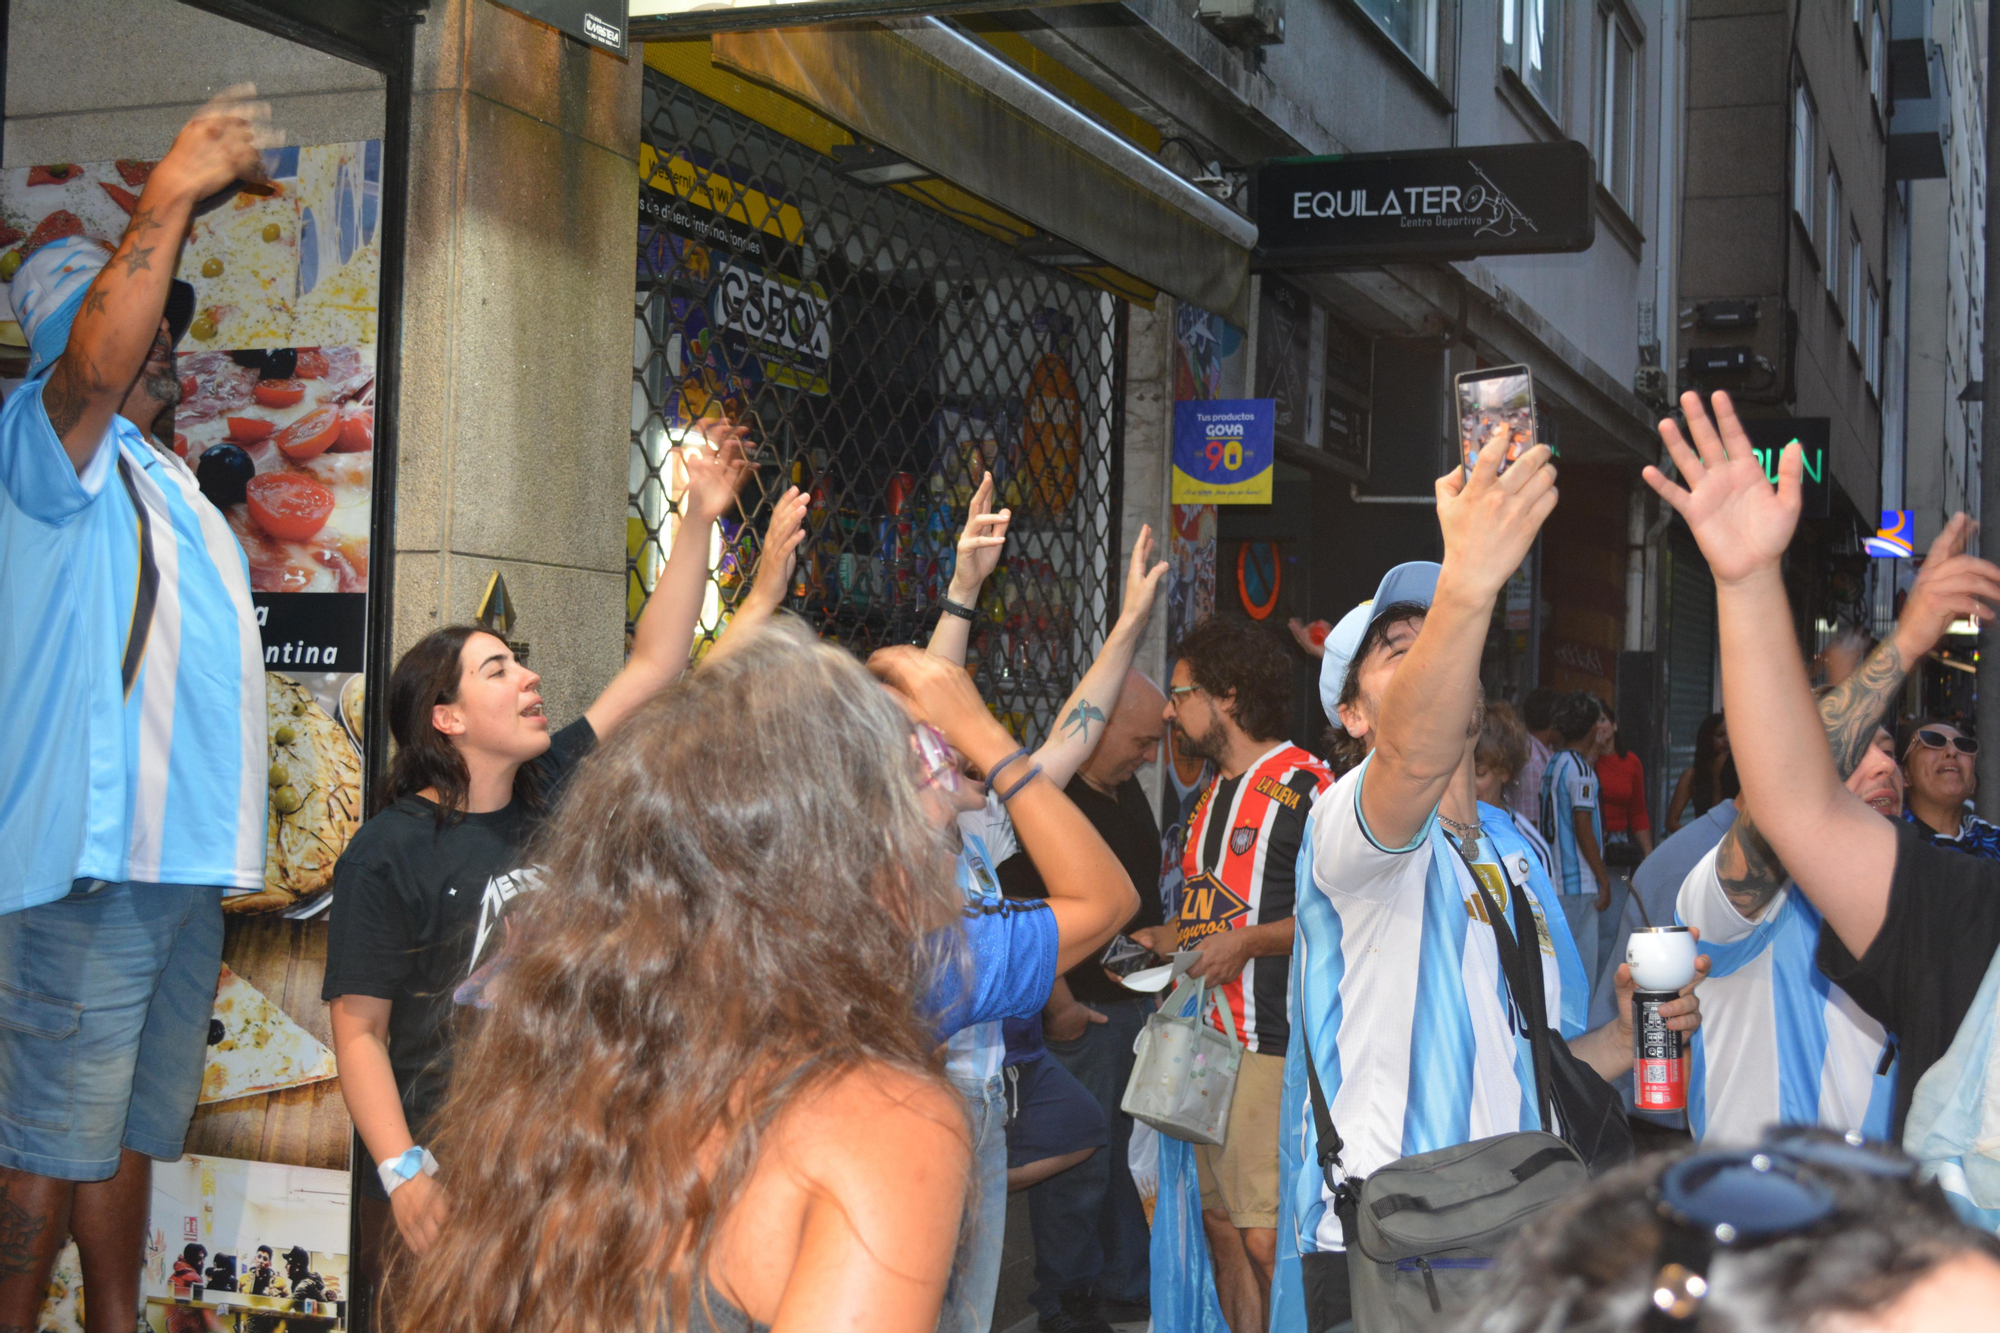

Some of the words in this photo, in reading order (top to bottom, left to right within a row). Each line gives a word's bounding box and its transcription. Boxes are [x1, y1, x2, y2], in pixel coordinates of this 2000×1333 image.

[1400, 215, 1432, 227] Centro
[1435, 214, 1482, 228] Deportivo
[1197, 413, 1211, 422] Tus
[1212, 412, 1255, 423] productos
[1205, 424, 1244, 437] GOYA
[1205, 441, 1243, 471] 90
[265, 640, 338, 665] ntina
[1256, 776, 1270, 793] LA
[1269, 781, 1301, 810] NUEVA
[1177, 918, 1229, 947] eguros
